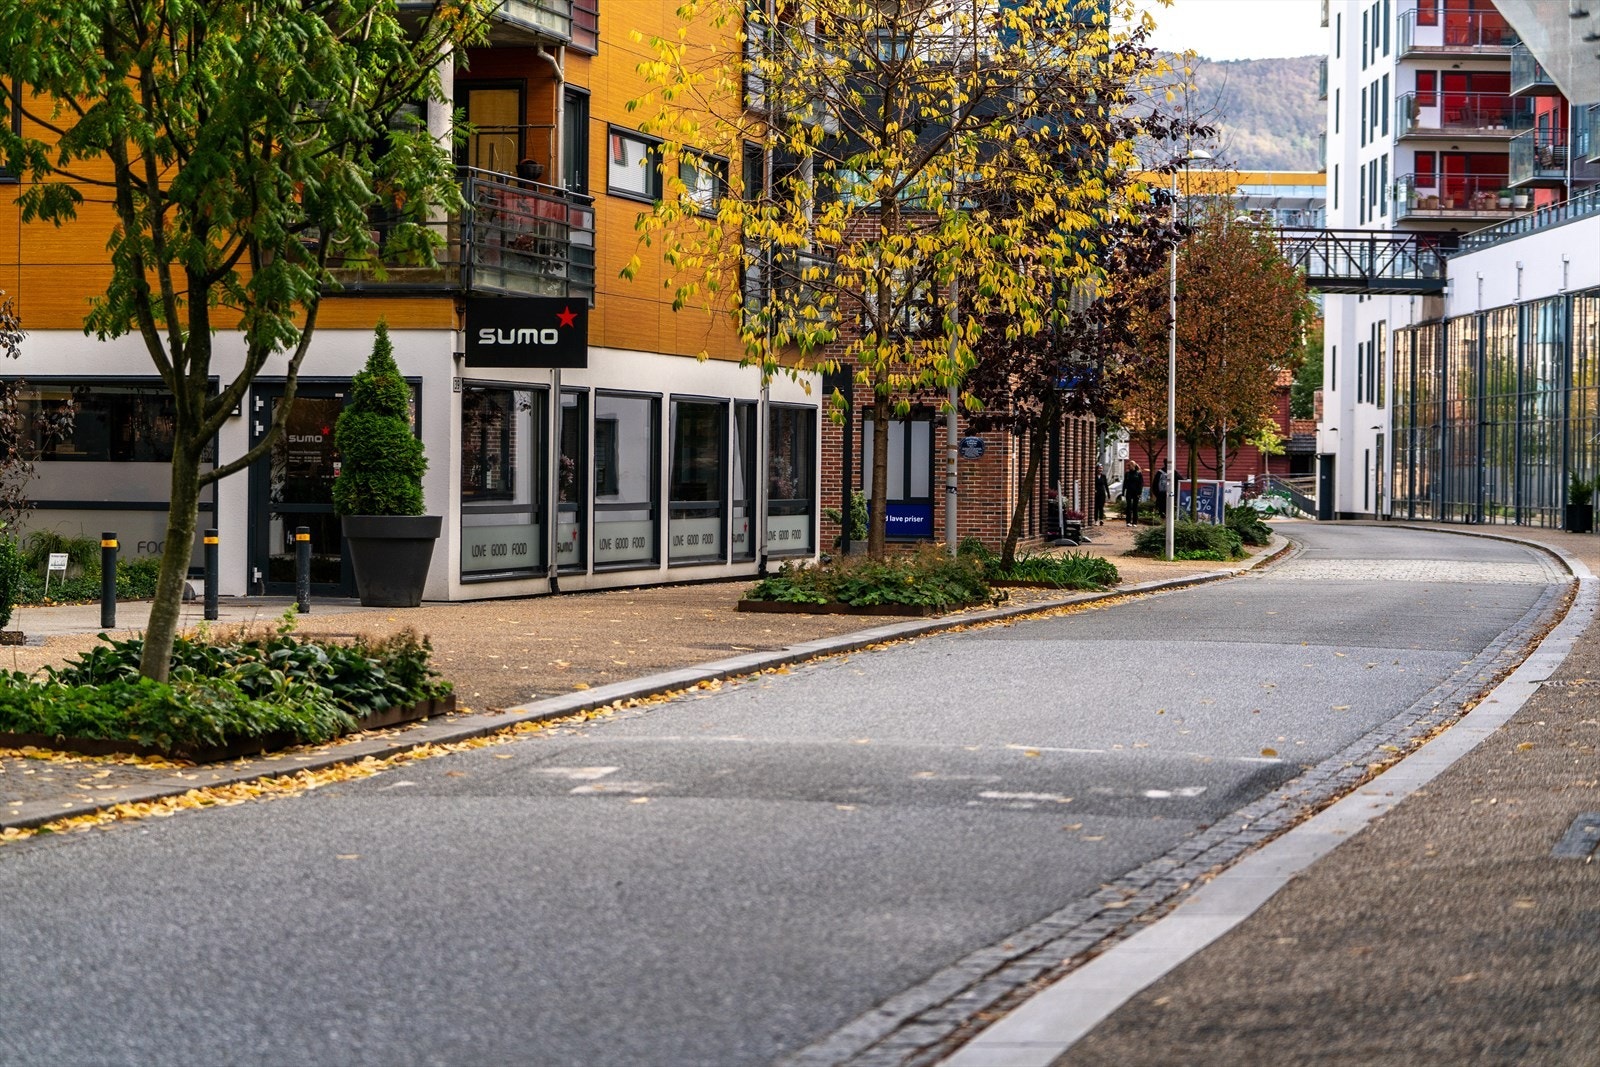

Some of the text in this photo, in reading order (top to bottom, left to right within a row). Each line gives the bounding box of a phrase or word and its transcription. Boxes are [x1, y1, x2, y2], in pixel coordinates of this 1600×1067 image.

[478, 328, 559, 345] SUMO
[288, 435, 323, 443] SUMO
[904, 515, 924, 523] priser
[672, 533, 714, 547] LOVE GOOD FOOD
[778, 529, 790, 541] GOOD
[791, 529, 802, 540] FOOD
[471, 542, 528, 558] LOVE GOOD FOOD
[599, 536, 646, 551] LOVE GOOD FOOD
